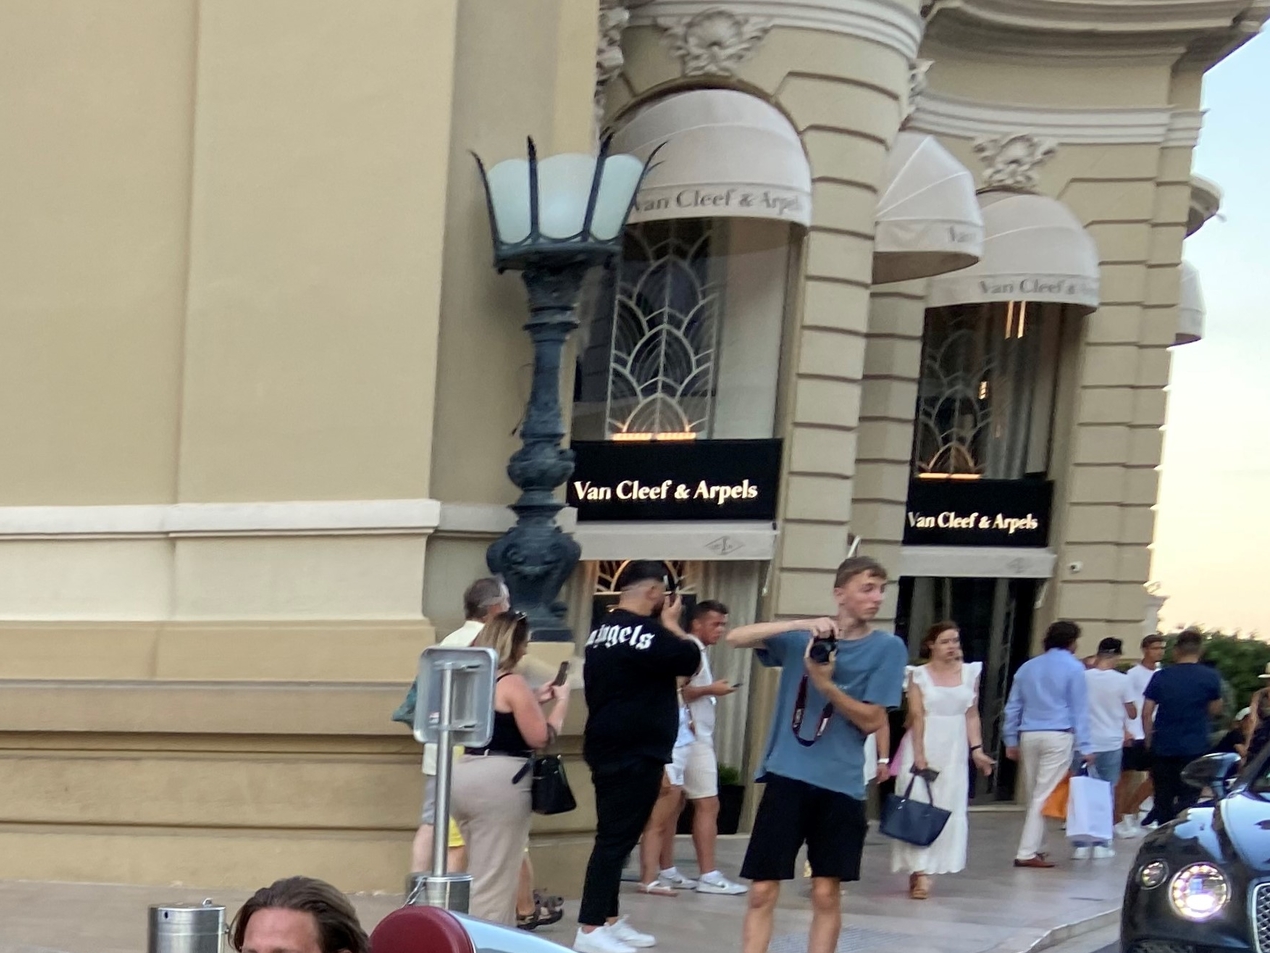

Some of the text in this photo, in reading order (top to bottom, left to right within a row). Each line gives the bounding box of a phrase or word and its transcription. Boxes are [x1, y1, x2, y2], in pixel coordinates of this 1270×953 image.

[675, 189, 737, 209] Cleef
[739, 192, 755, 208] &
[980, 280, 1013, 295] Van
[1019, 278, 1065, 295] Cleef
[573, 479, 759, 506] Van Cleef & Arpels
[907, 511, 1039, 535] Van Cleef & Arpels
